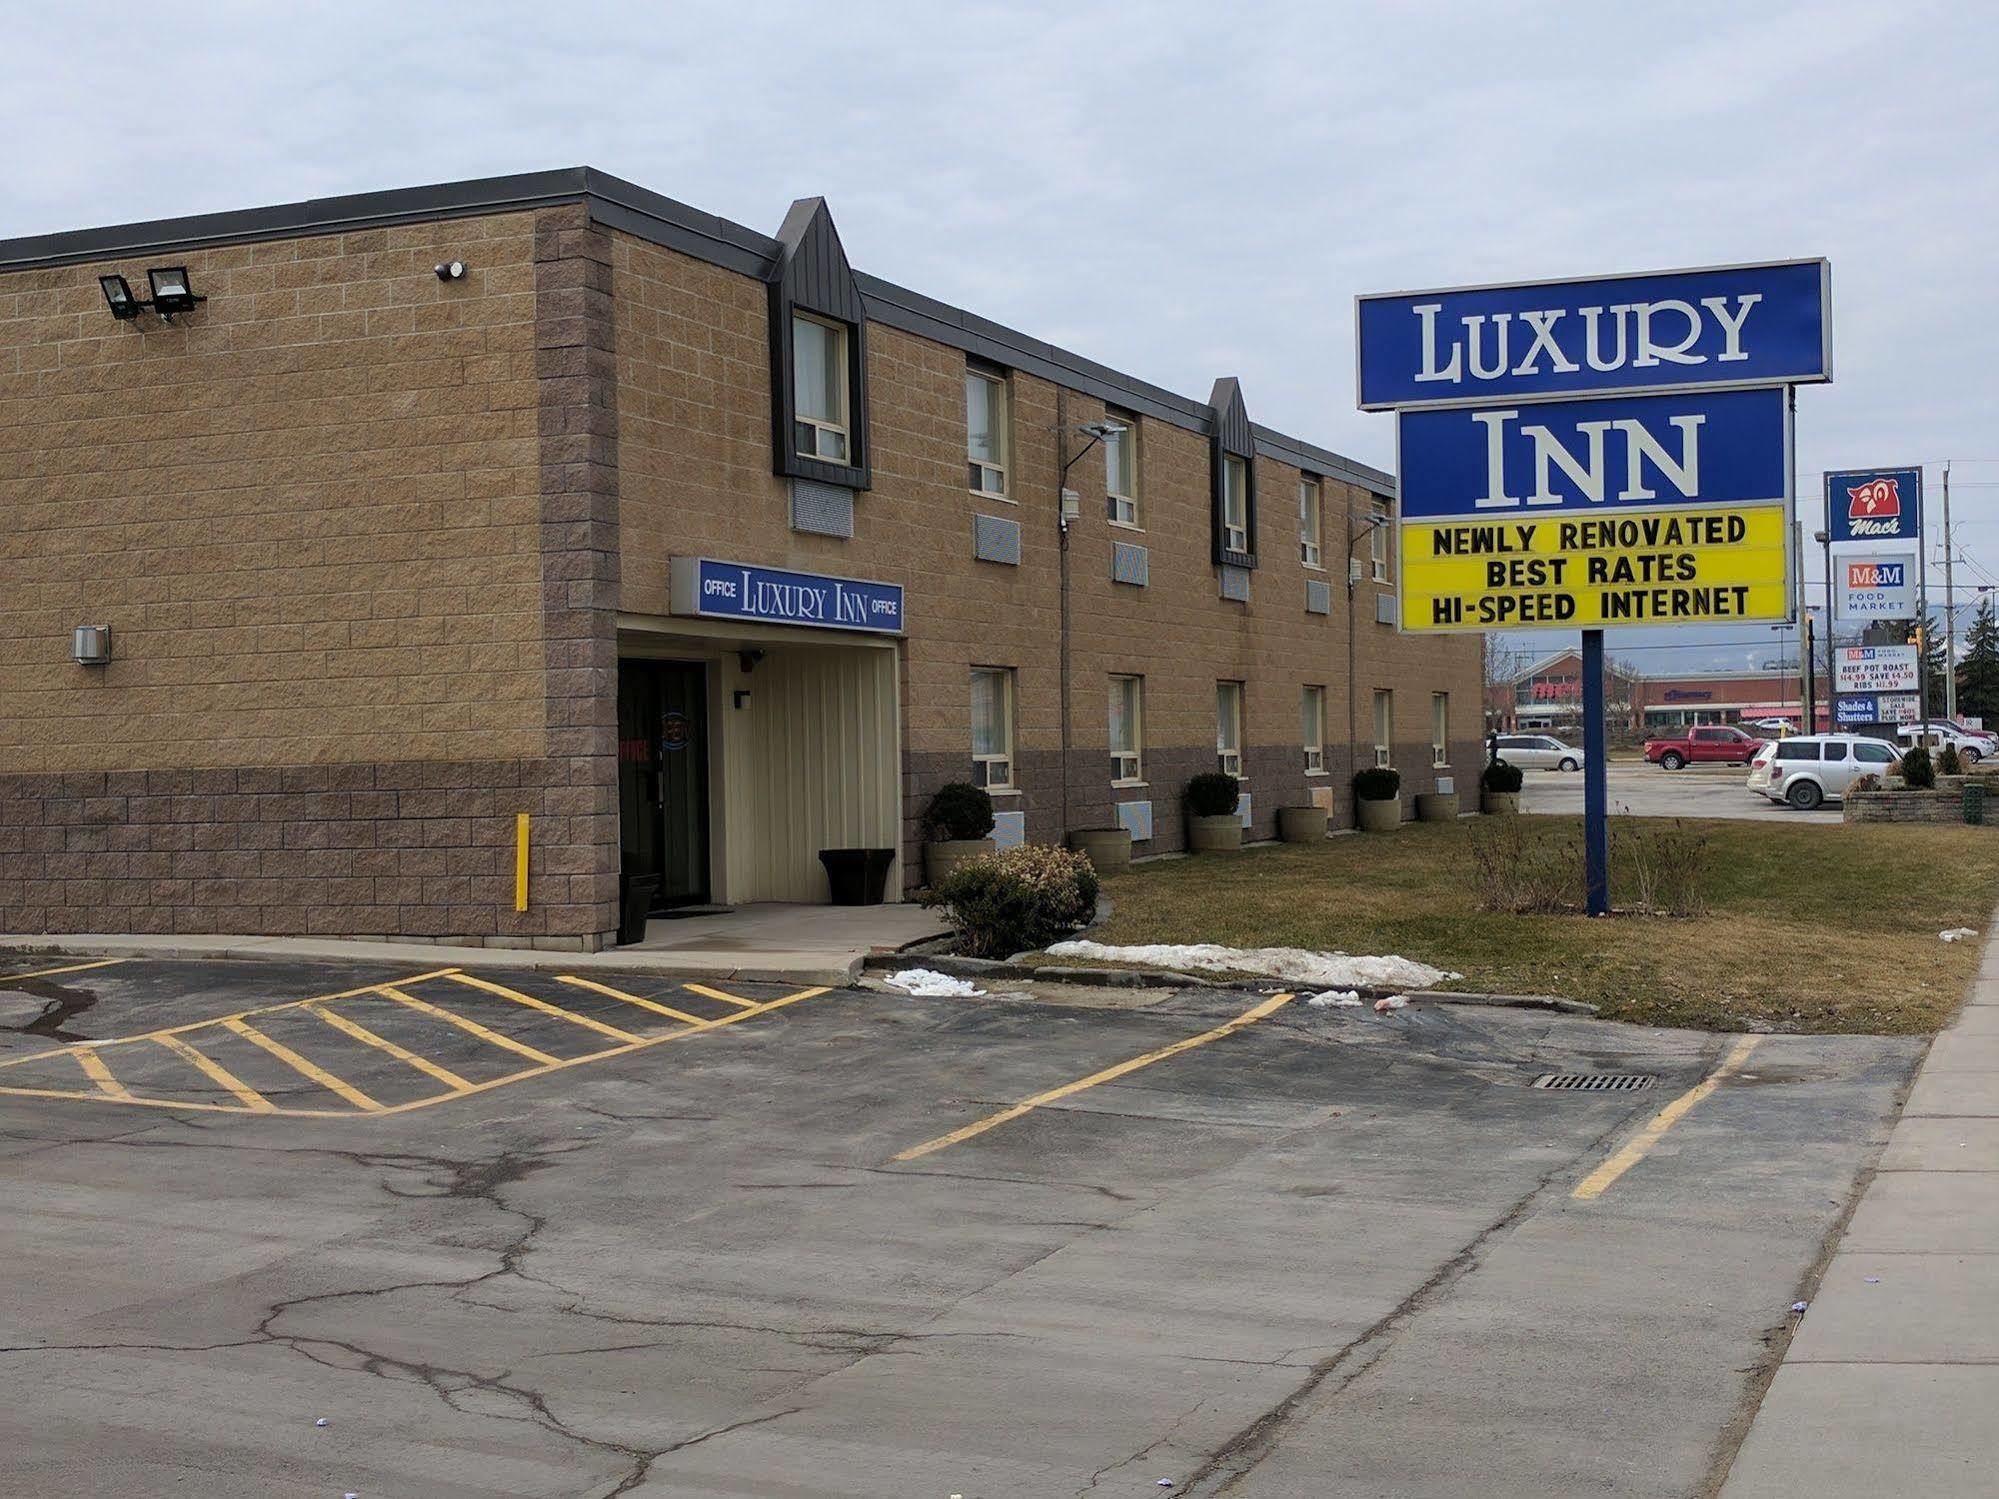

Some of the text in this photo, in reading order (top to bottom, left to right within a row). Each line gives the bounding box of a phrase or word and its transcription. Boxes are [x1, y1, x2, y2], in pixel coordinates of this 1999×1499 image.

[1413, 293, 1762, 383] LUXURY
[1472, 410, 1706, 508] INN
[1433, 515, 1746, 556] NEWLY RENOVATED
[1849, 518, 1901, 536] Mac's
[1487, 553, 1697, 588] BEST RATES
[1851, 566, 1901, 585] M&M
[704, 570, 897, 624] OFFICE LUXURY INN OFFICE
[1433, 586, 1749, 625] HI-SPEED INTERNET
[1849, 592, 1885, 601] FOOD
[1849, 602, 1904, 611] MARKET
[1842, 663, 1909, 673] BEEF POT ROAST
[1869, 672, 1890, 680] SAVE
[1837, 700, 1873, 711] Shades &
[1837, 711, 1873, 722] Shutters
